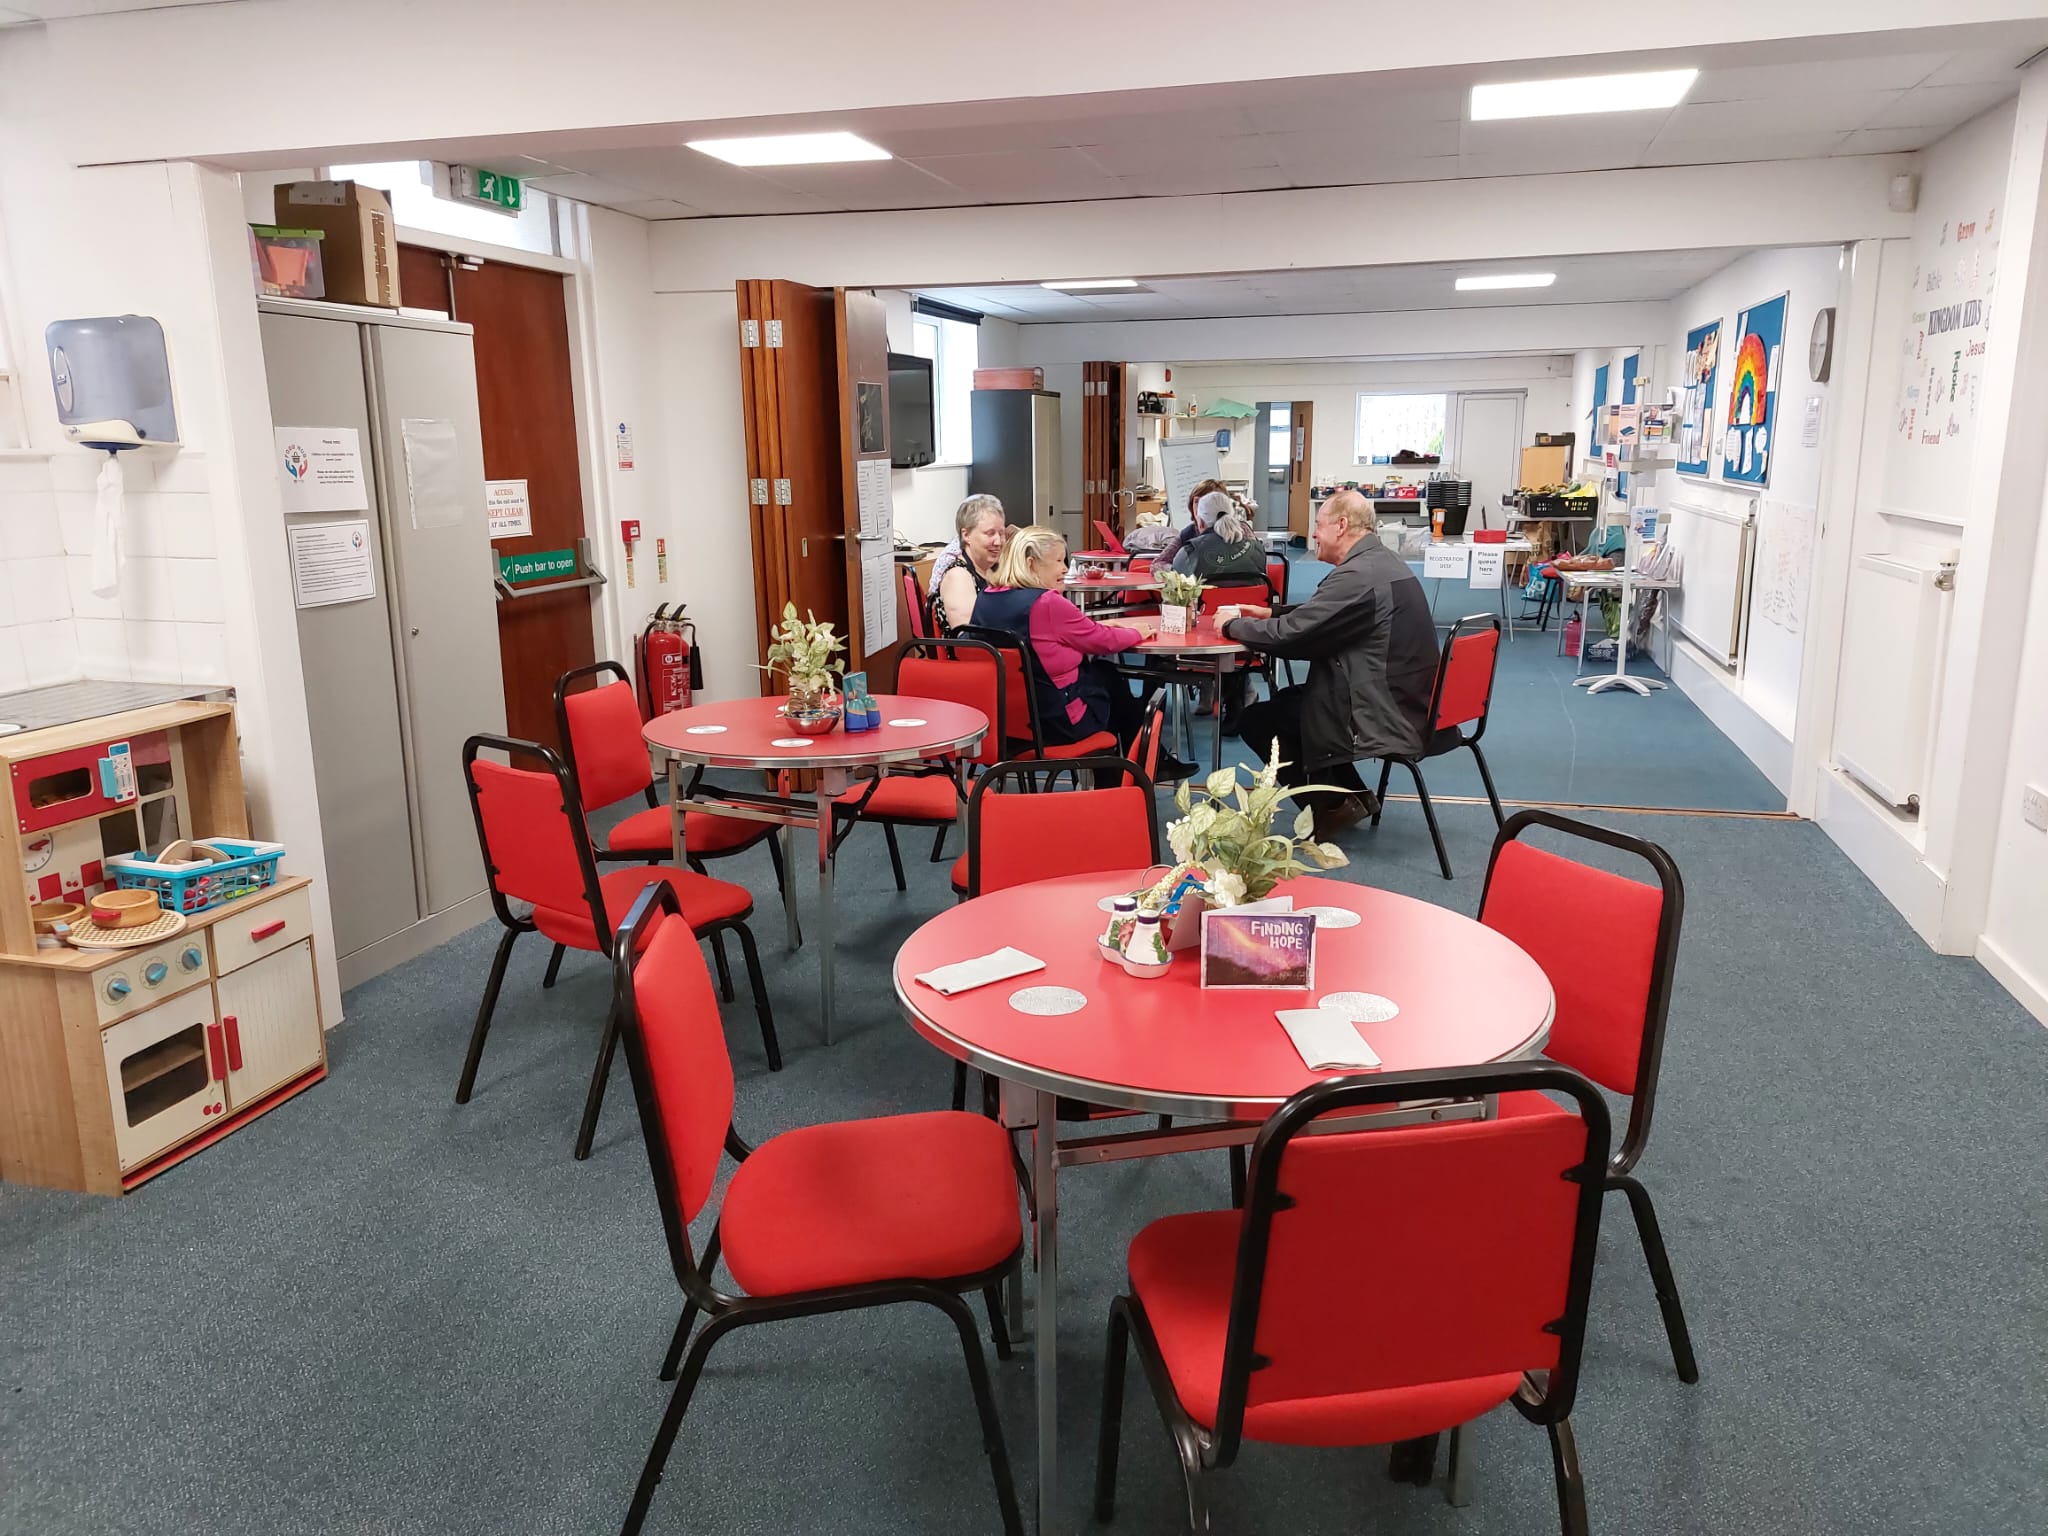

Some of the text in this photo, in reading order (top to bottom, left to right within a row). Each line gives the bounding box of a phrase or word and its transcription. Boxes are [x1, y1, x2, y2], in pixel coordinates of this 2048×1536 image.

[1928, 303, 1962, 335] KINGDOM
[1963, 299, 1982, 328] KIDS
[1965, 339, 1985, 357] Jesus
[1950, 350, 1961, 402] Rejoice
[514, 559, 574, 575] Push bar to open
[1250, 920, 1304, 937] FINDING
[1269, 936, 1303, 950] HOPE
